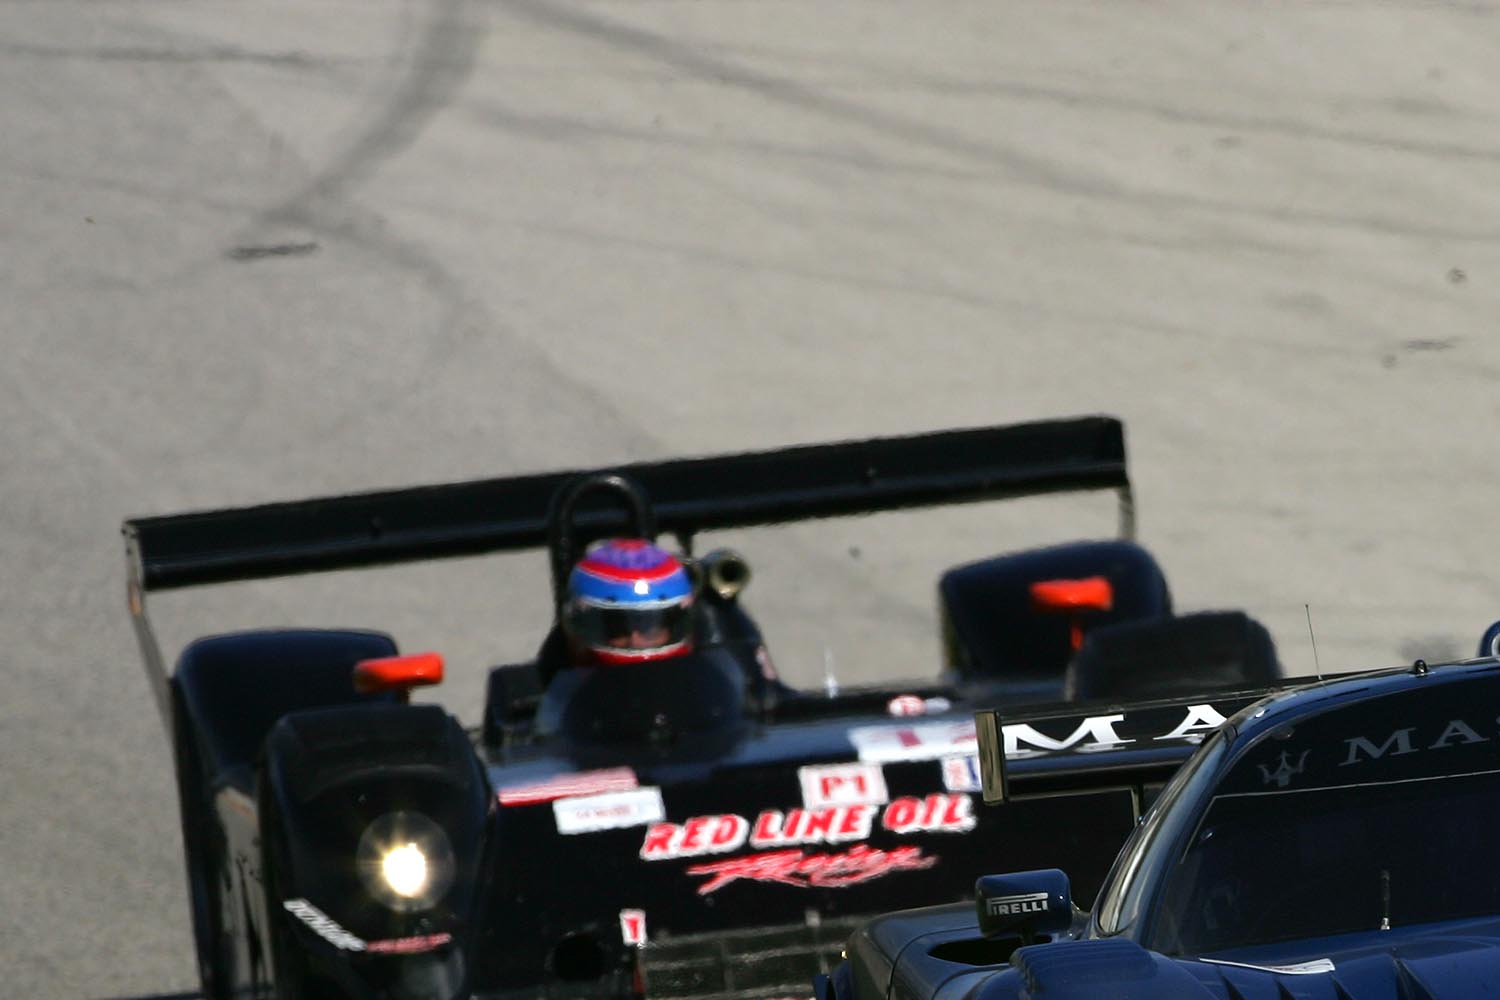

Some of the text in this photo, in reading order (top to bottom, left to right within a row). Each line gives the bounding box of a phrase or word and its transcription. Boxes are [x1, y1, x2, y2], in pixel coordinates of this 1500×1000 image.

[820, 775, 868, 799] P1
[641, 794, 977, 860] RED LINE OIL
[986, 892, 1048, 915] PIRELLI
